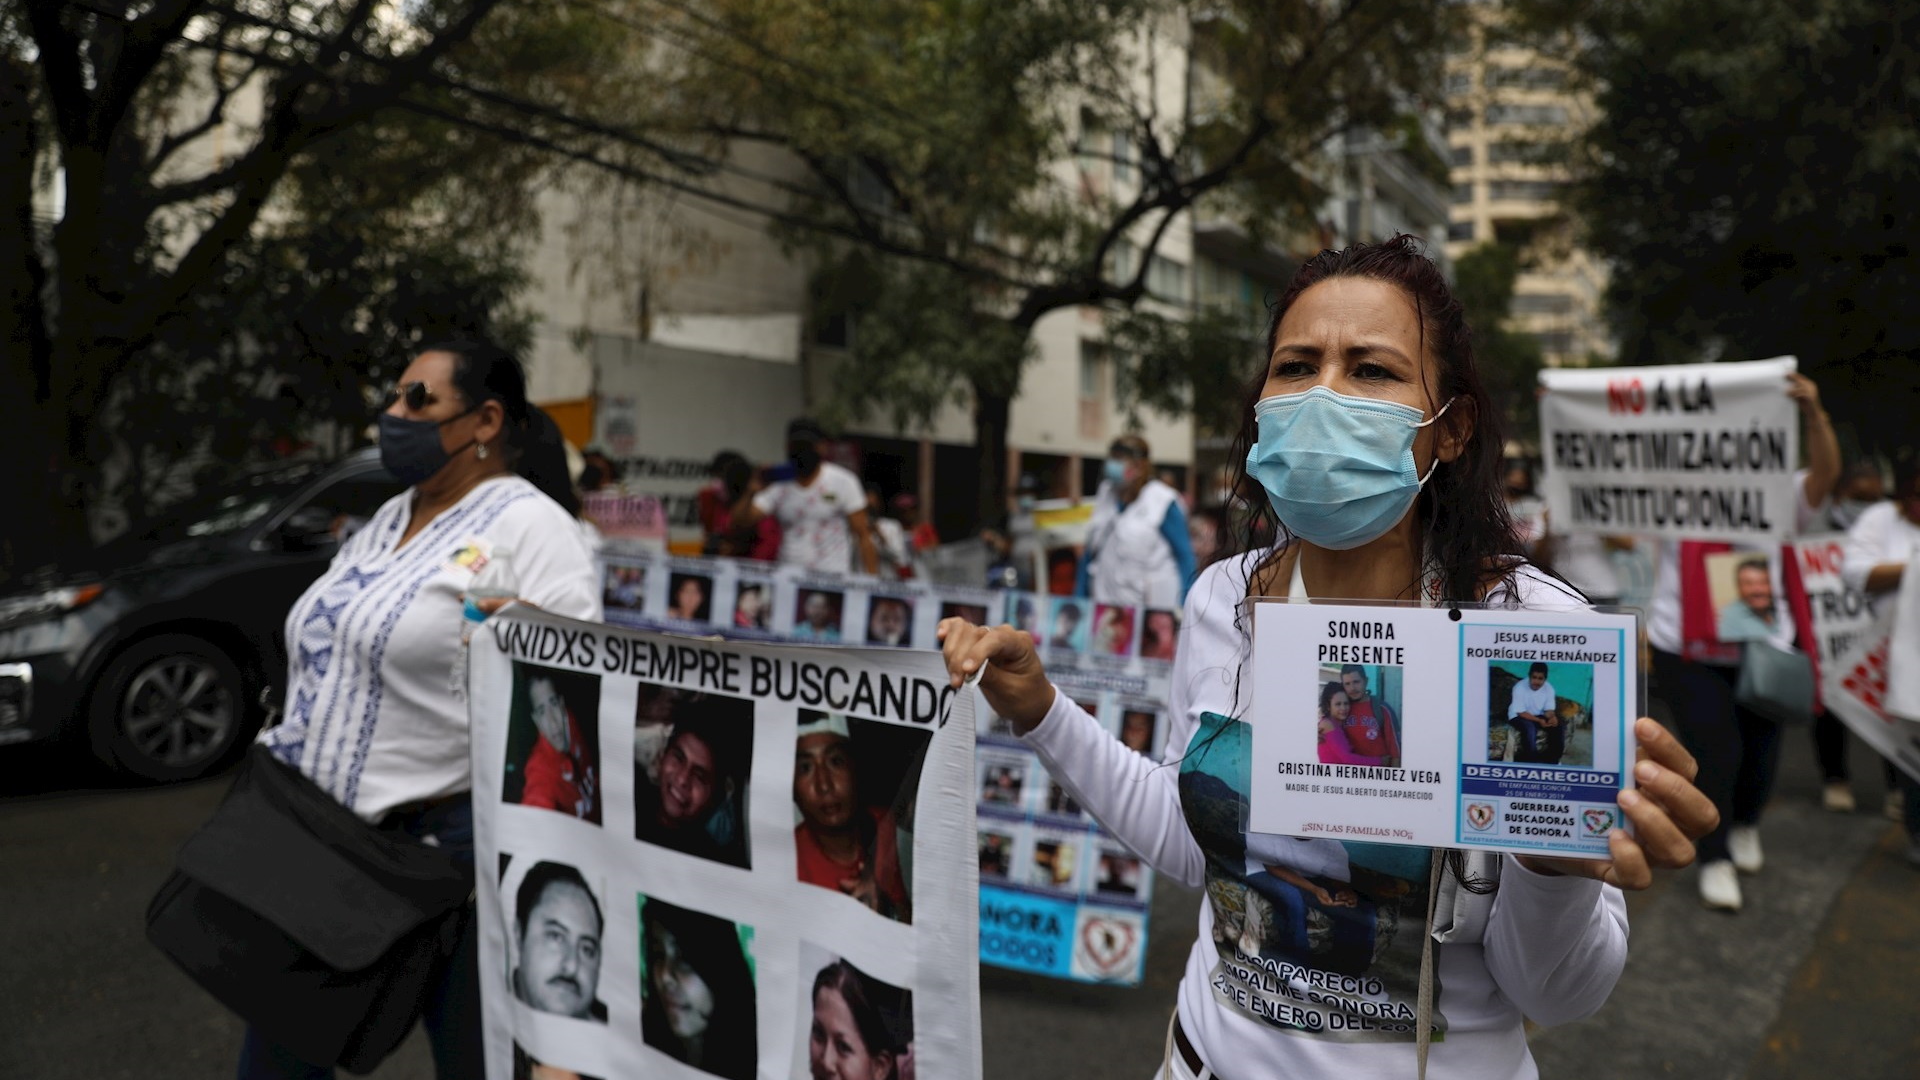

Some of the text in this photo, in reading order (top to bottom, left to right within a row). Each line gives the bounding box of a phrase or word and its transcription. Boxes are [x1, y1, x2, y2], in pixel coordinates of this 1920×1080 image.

[1607, 377, 1715, 415] NO A LA
[1554, 420, 1786, 471] REVICTIMIZACIÓN
[1570, 484, 1773, 530] INSTITUCIONAL
[1328, 620, 1395, 640] SONORA
[1494, 632, 1587, 645] JESUS ALBERTO
[494, 621, 597, 668] UNIDXS
[603, 635, 740, 692] SIEMPRE
[1318, 644, 1404, 664] PRESENTE
[1466, 648, 1617, 663] RODRÍGUEZ HERNÁNDEZ
[1278, 762, 1441, 784] CRISTINA HERNÁNDEZ VEGA
[1466, 766, 1615, 785] DESAPARECIDO
[1285, 783, 1433, 800] MADRE DE JESUS ALBERTO DESAPARECIDO
[1498, 781, 1572, 793] EN EMPALME SONORA
[1525, 791, 1547, 799] ENERO
[1510, 802, 1569, 814] GUERRERAS
[1504, 813, 1575, 826] BUSCADORAS
[1326, 824, 1343, 833] LAS
[1345, 825, 1390, 837] FAMILIAS
[1509, 826, 1570, 838] DE SONORA
[979, 930, 1058, 968] ODOS
[1252, 995, 1323, 1028] ENERO
[1329, 1012, 1374, 1031] DEL
[1308, 992, 1415, 1019] SONORA
